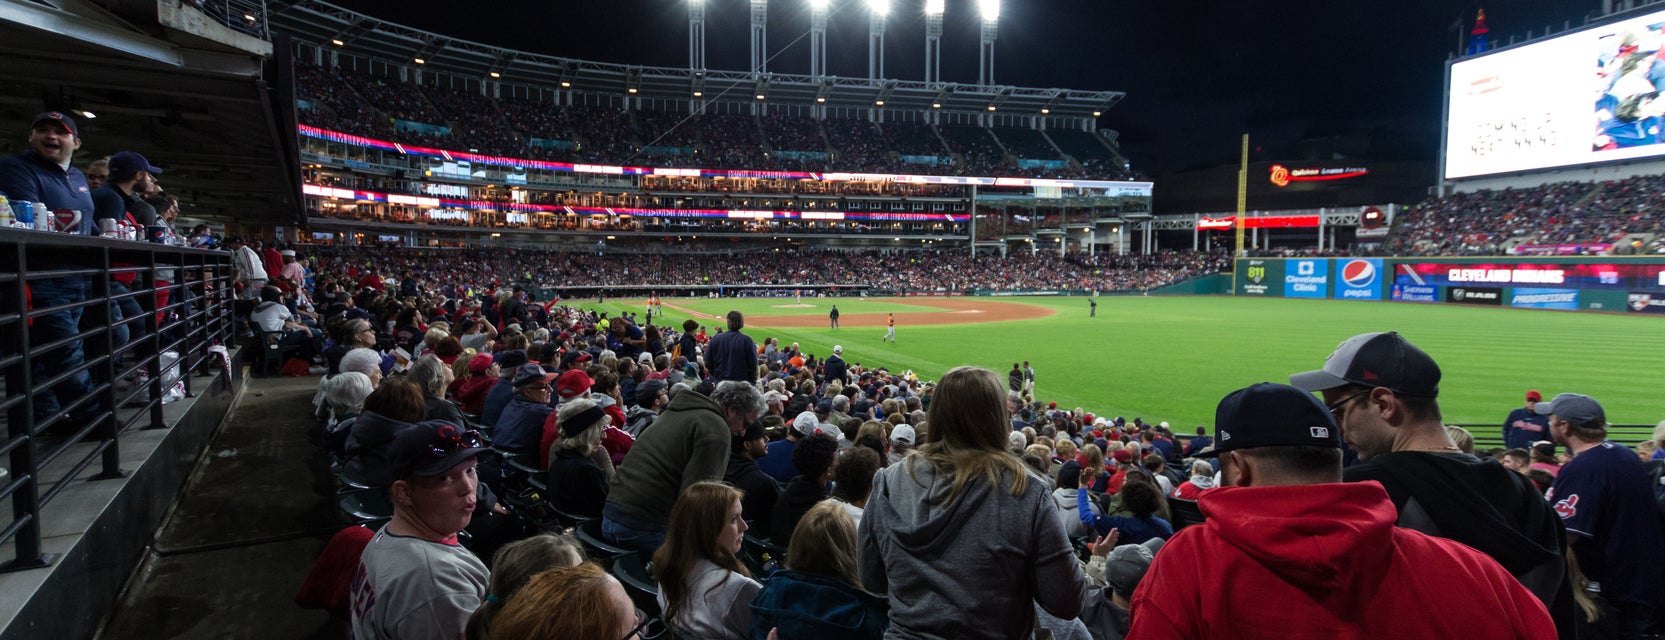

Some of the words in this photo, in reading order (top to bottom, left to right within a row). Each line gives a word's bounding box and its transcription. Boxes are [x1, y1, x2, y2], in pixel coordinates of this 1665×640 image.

[1247, 266, 1265, 279] 811
[1448, 269, 1511, 282] CLEVELAND
[1512, 269, 1564, 284] INDIANS
[1285, 275, 1327, 283] Cleveland
[1293, 284, 1317, 292] Clinic
[1344, 289, 1372, 298] pepsi
[1465, 291, 1498, 299] RAM
[1512, 293, 1577, 303] PROGRESSIVE
